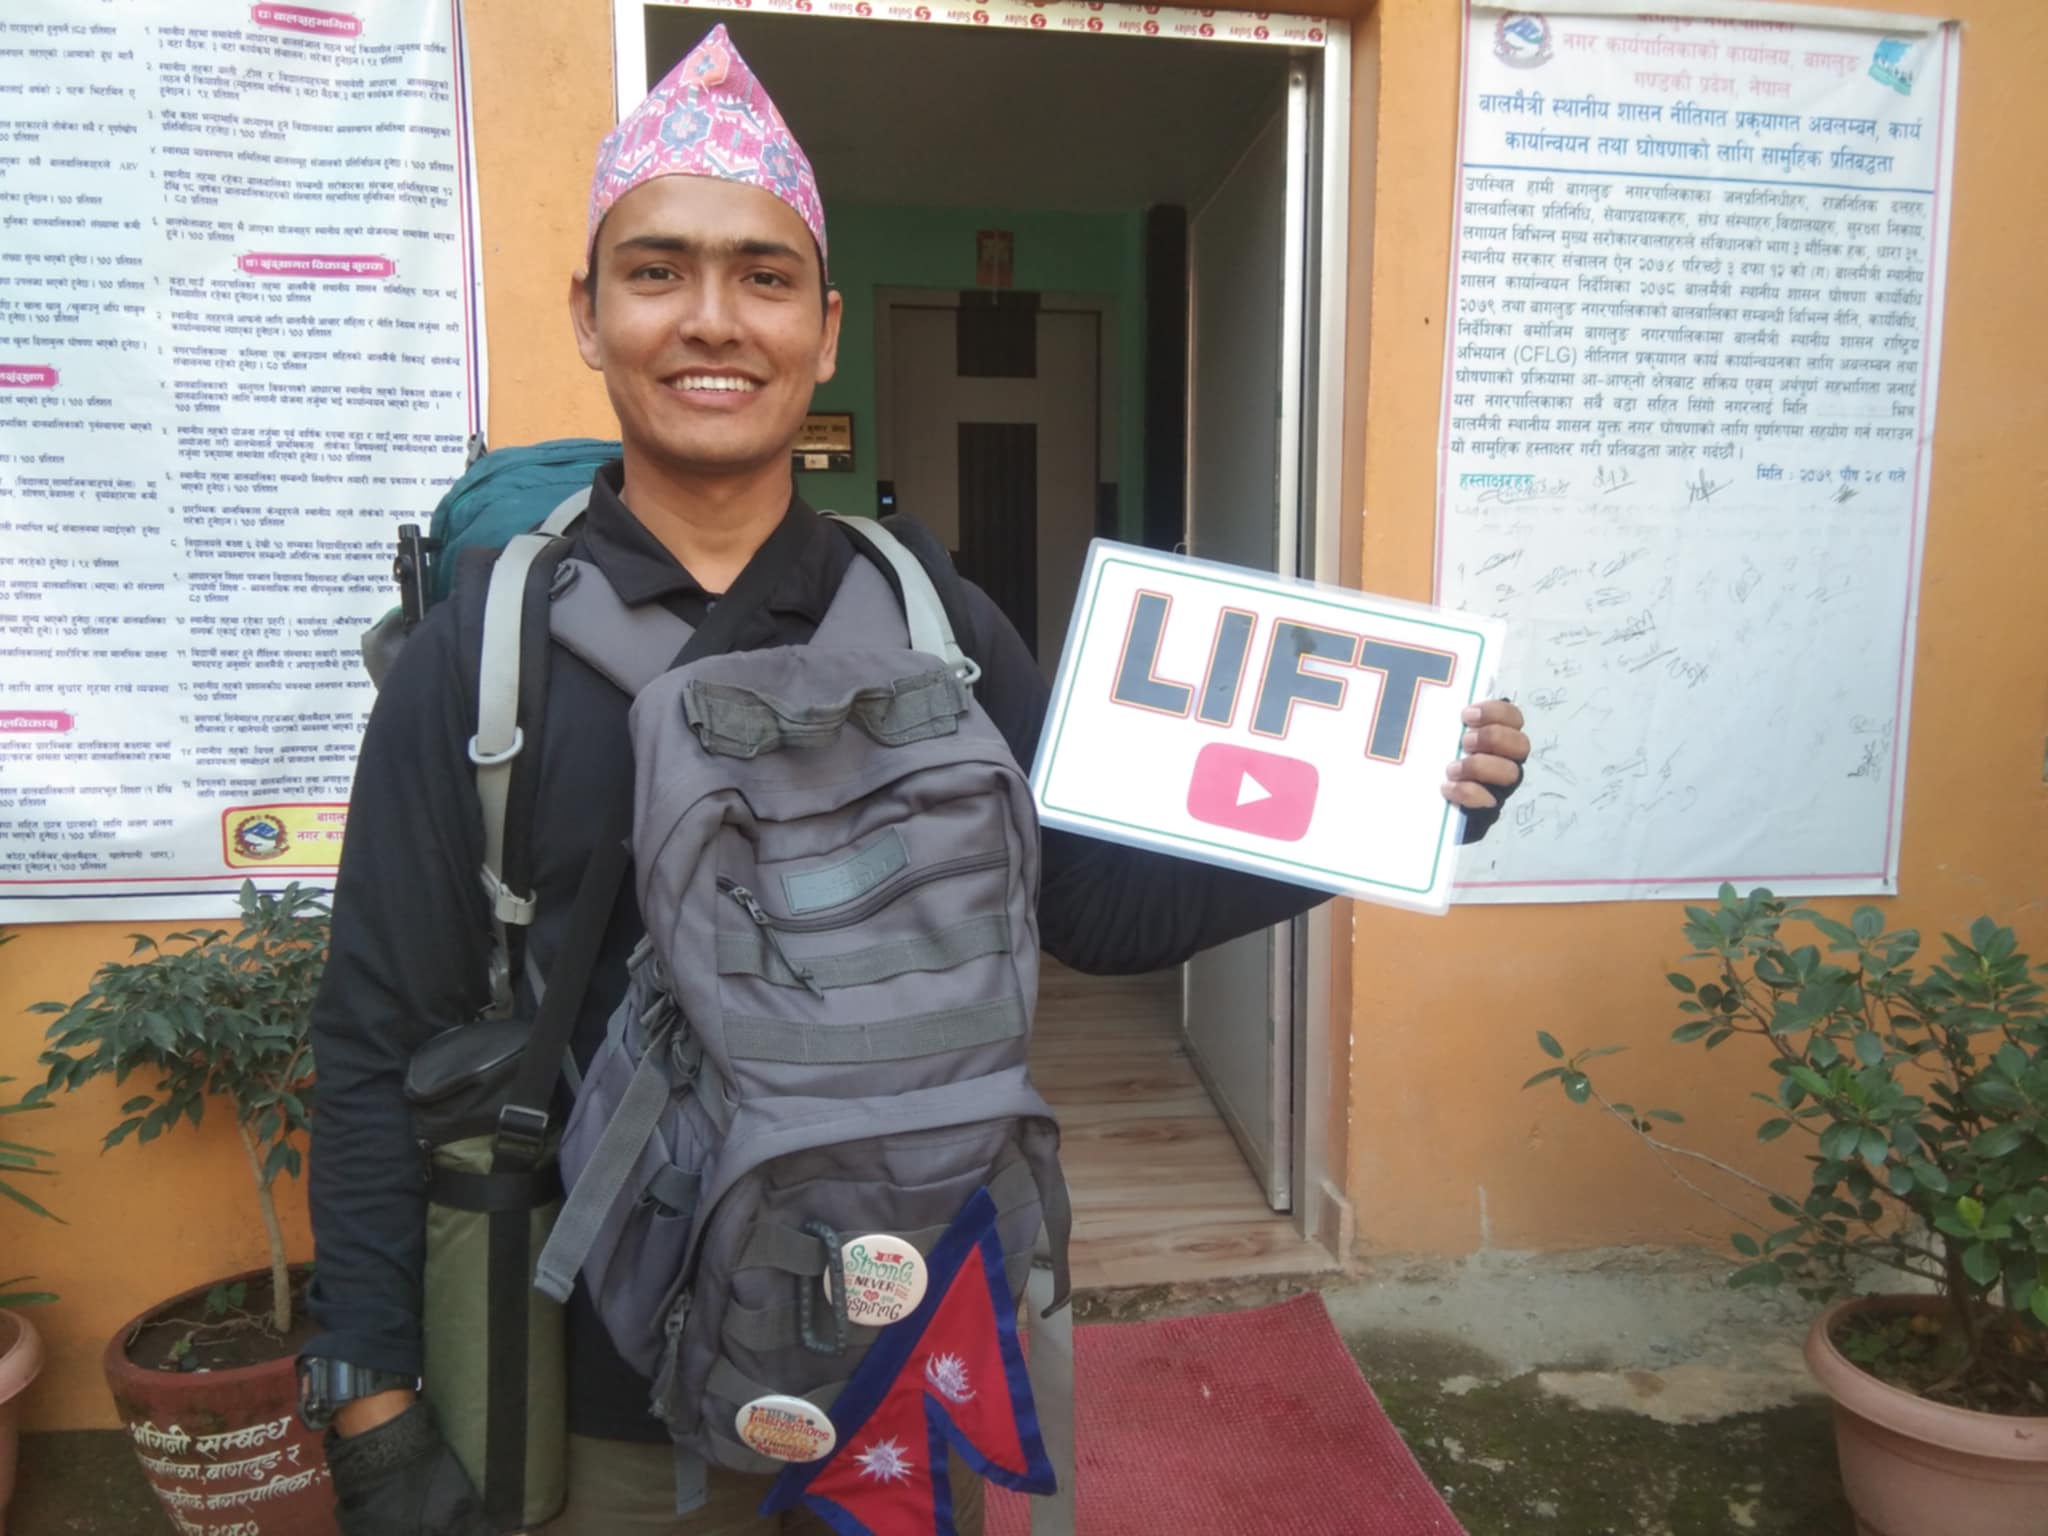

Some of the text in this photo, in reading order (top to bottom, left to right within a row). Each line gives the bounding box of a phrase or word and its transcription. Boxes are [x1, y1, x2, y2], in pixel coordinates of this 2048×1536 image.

[1563, 32, 1599, 49] नगर
[1478, 88, 1545, 115] बालमैत्री
[1552, 94, 1610, 119] स्थानीय
[1618, 101, 1662, 122] शासन
[1669, 99, 1728, 127] नीतिगत
[1888, 117, 1923, 139] कार्य
[1505, 128, 1591, 153] कार्यान्वयन
[1598, 136, 1628, 155] तथा
[1637, 135, 1711, 161] घोषणाको
[1717, 139, 1754, 164] लागि
[1762, 144, 1822, 173] सामुहिक
[1465, 173, 1514, 193] उपस्थित
[1527, 176, 1553, 194] हामी
[1464, 199, 1534, 217] बालबालिका
[1463, 226, 1508, 240] लगायत
[1461, 247, 1506, 265] स्थानीय
[1512, 252, 1556, 267] सरकार
[1460, 275, 1496, 289] शासन
[1502, 299, 1526, 314] तथा
[1513, 344, 1577, 367] (CFLG)
[1109, 587, 1459, 766] LIFT
